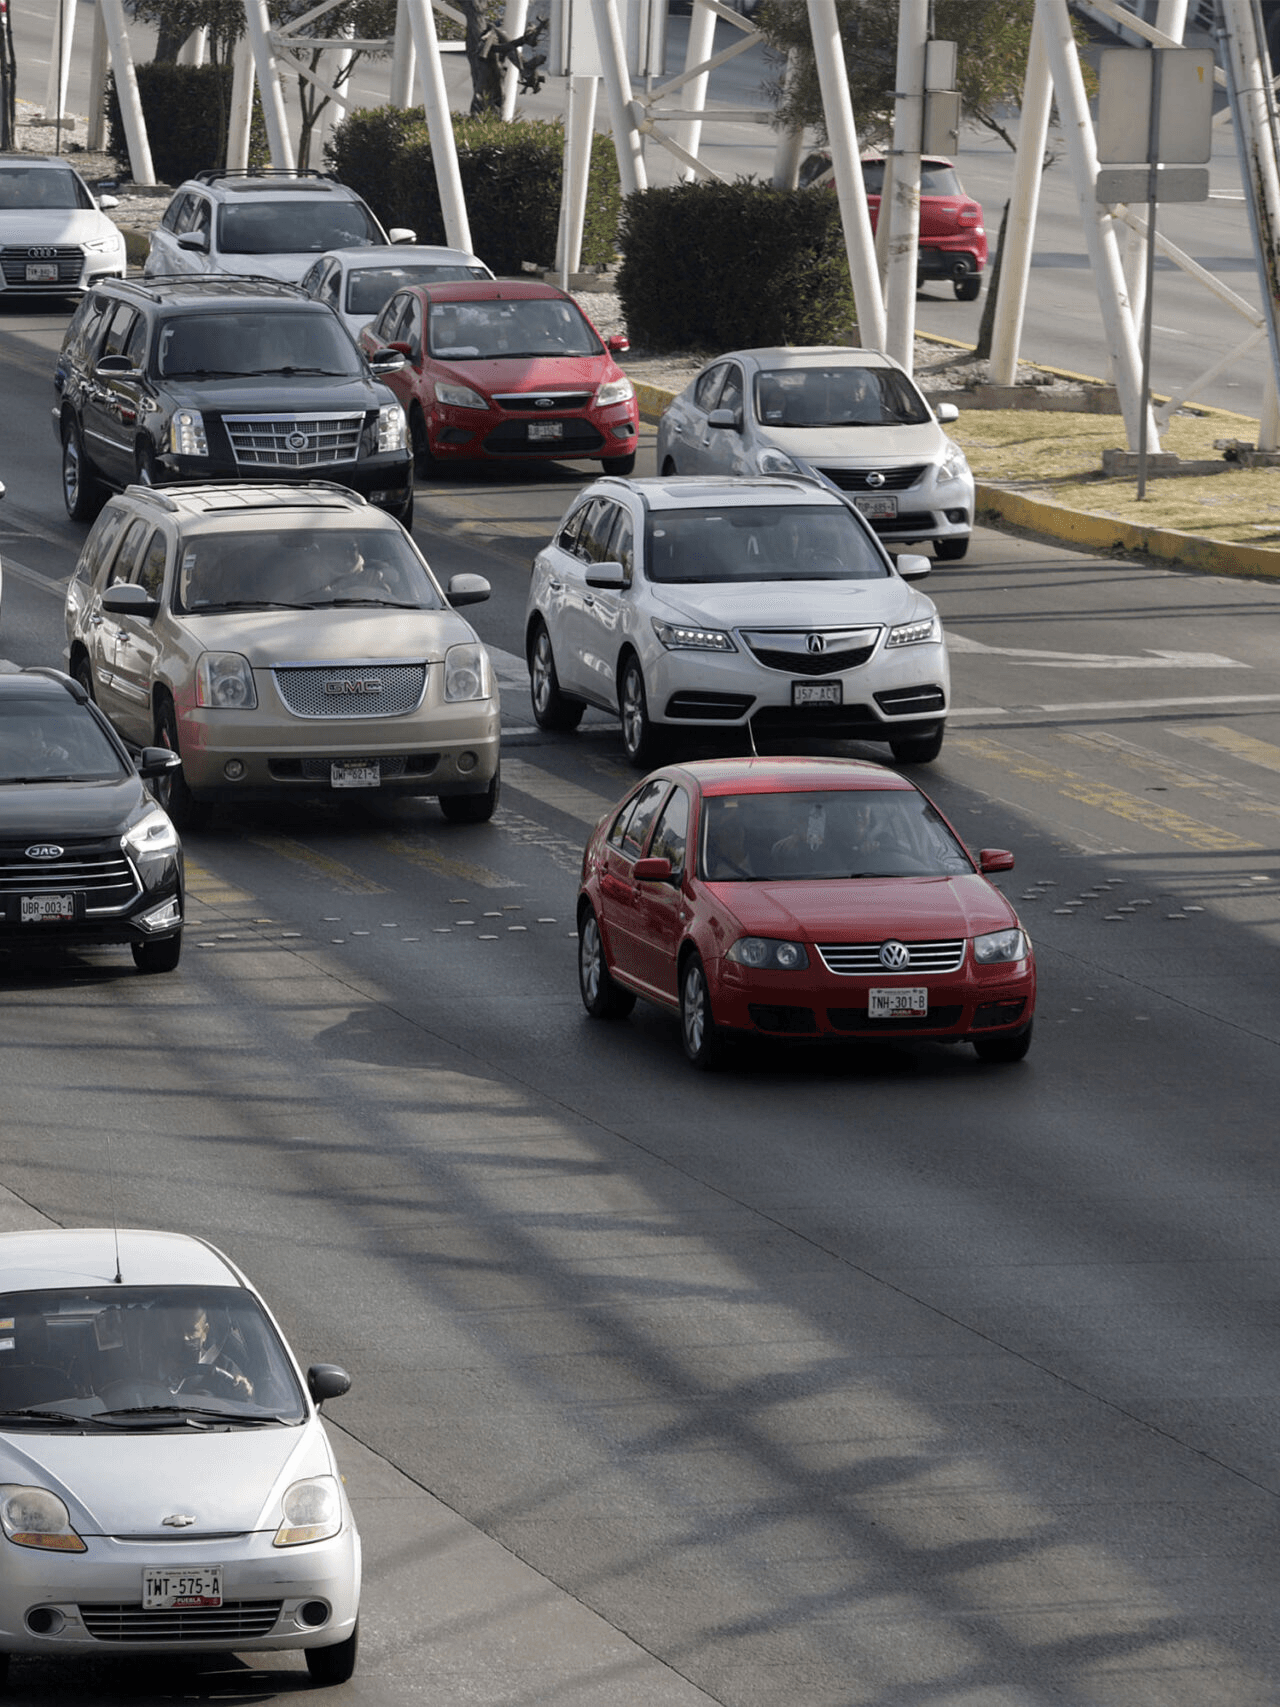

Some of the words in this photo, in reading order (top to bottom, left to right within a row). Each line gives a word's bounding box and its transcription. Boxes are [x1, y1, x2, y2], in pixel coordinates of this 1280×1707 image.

[325, 681, 382, 694] GMC
[31, 847, 59, 856] JAC
[22, 901, 73, 915] UBR-003-A
[871, 995, 926, 1009] TNH-301-B
[146, 1577, 220, 1596] TWT-575-A
